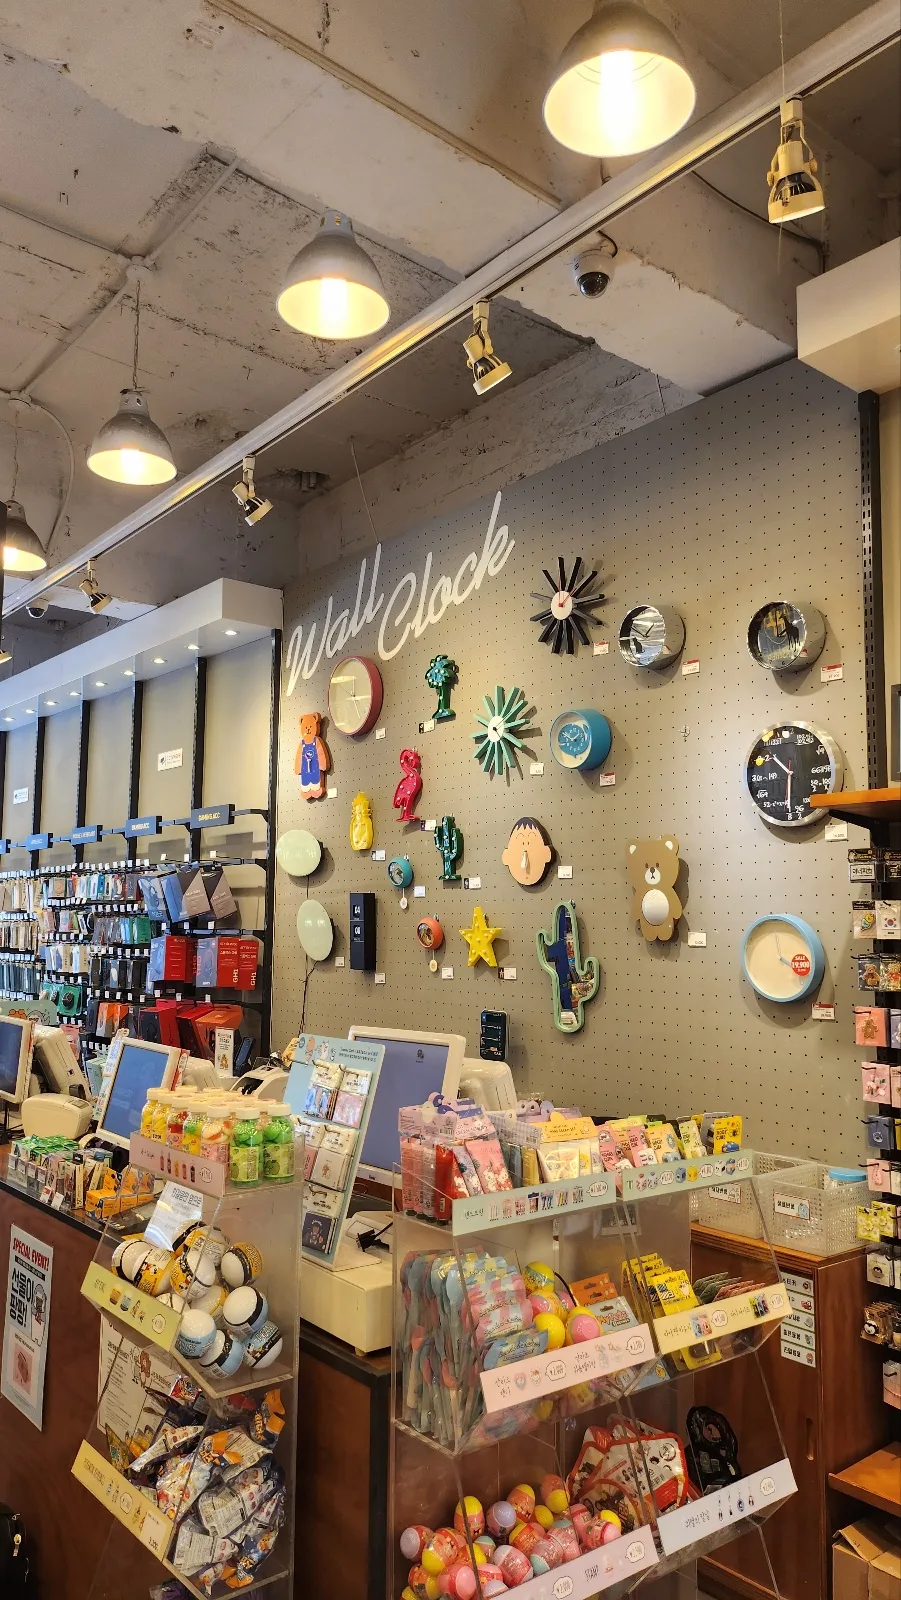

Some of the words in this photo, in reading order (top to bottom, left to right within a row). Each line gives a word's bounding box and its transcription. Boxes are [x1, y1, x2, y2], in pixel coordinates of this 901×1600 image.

[286, 542, 385, 697] Wall
[378, 491, 516, 661] Clock
[12, 1237, 32, 1262] SPECIAL
[31, 1249, 50, 1272] EVENT!
[11, 1267, 34, 1303] 선물이
